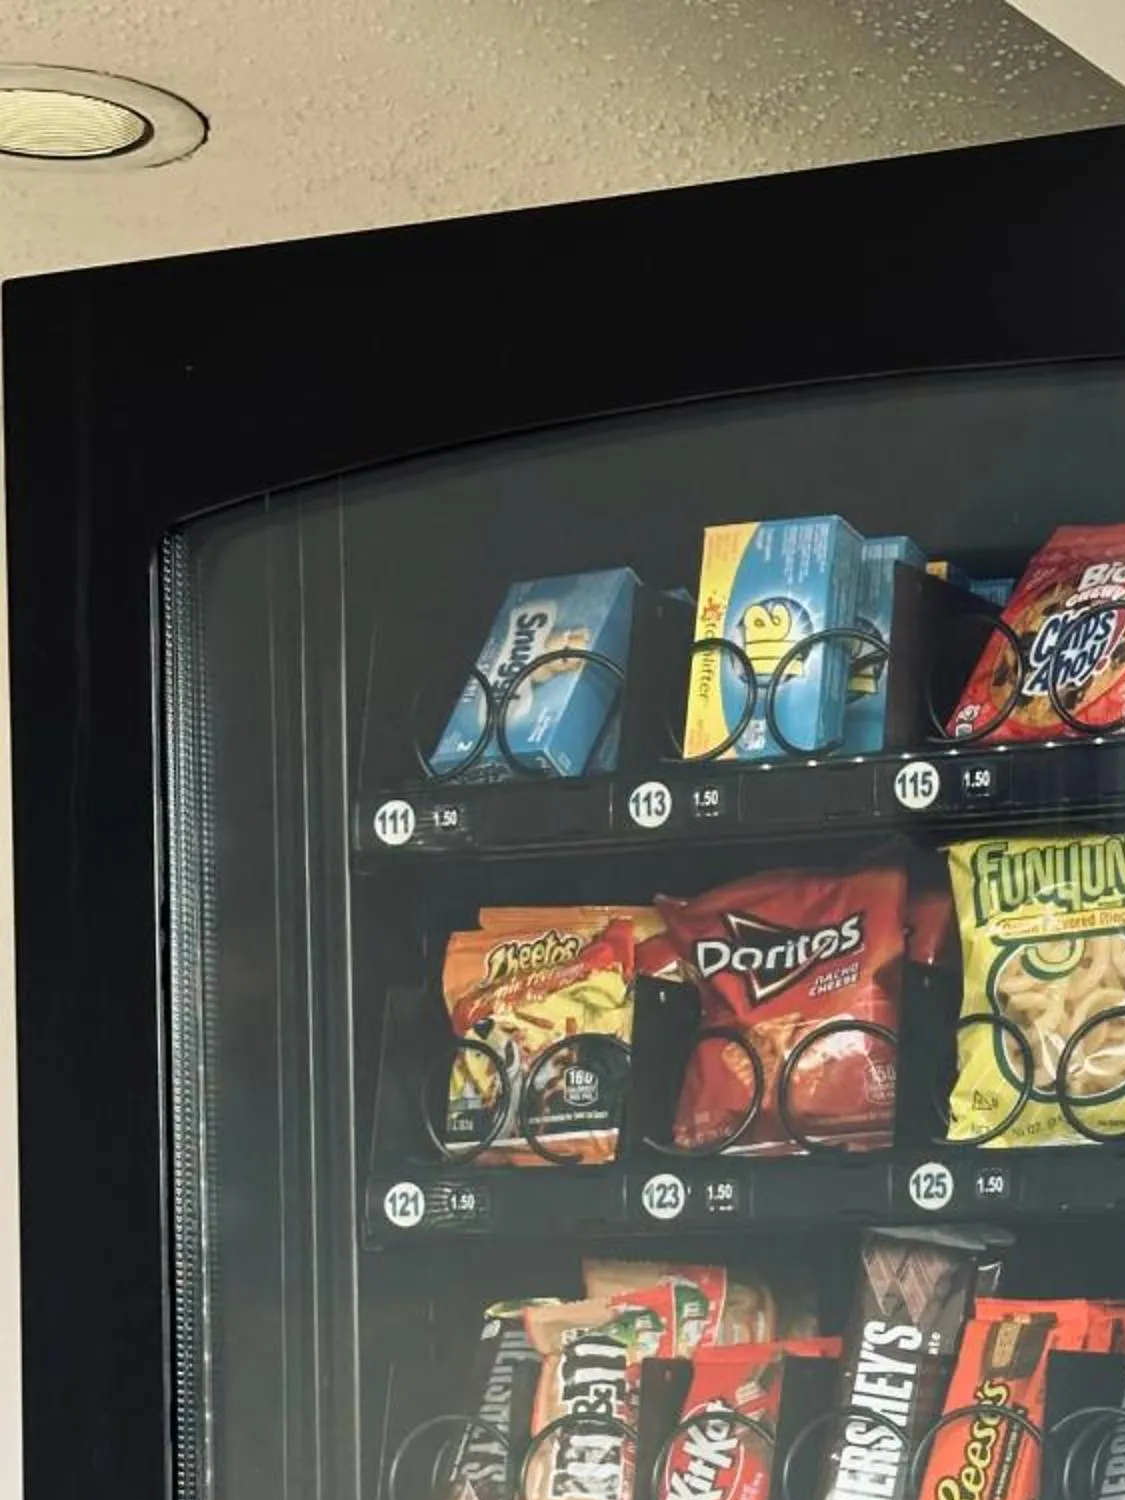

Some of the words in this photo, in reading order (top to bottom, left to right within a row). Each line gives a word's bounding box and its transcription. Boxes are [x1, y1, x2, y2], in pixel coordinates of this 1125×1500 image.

[897, 772, 934, 797] 115
[963, 770, 990, 787] 1.50
[631, 792, 666, 817] 113
[693, 789, 719, 807] 1.50
[377, 810, 410, 835] 111
[480, 929, 582, 988] Cheetos
[697, 916, 862, 978] Doritos
[643, 1184, 680, 1209] 123
[706, 1184, 732, 1200] 1.50
[911, 1174, 947, 1199] 125
[977, 1176, 1004, 1194] 1.50
[388, 1191, 421, 1217] 121
[451, 1193, 475, 1210] 1.50
